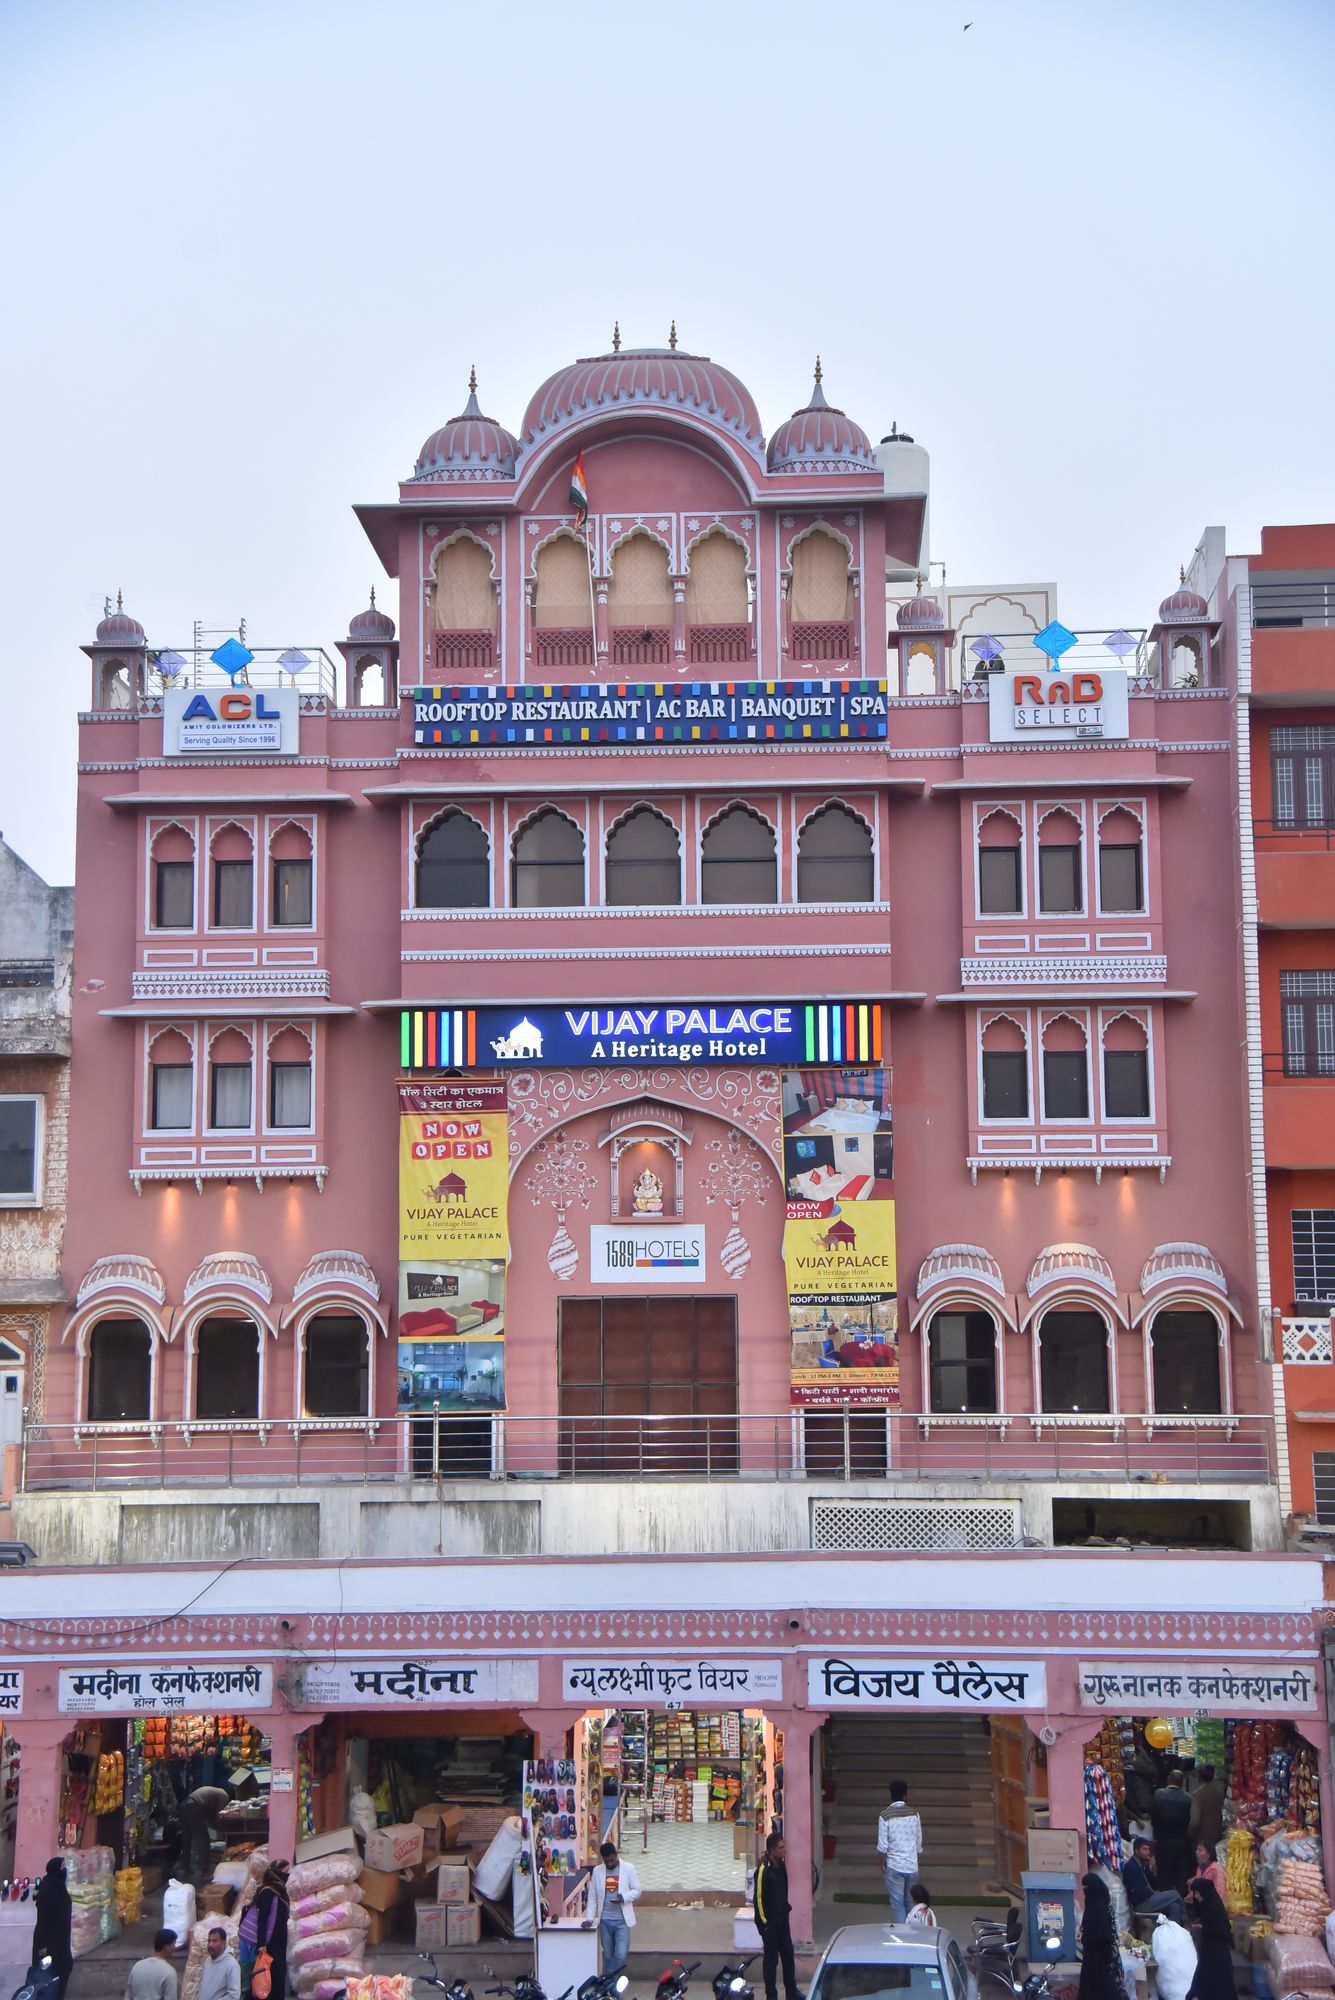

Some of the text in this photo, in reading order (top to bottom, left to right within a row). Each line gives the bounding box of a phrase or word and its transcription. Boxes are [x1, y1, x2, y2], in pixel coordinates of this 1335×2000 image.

[182, 694, 280, 720] ACL
[415, 696, 887, 722] ROOFTOP RESTAURANT AC BAR BANQUET SPA
[1018, 708, 1102, 724] SELECT
[184, 737, 210, 745] Serving
[212, 736, 237, 745] Quality
[239, 736, 258, 744] Since
[565, 1008, 792, 1035] VIJAY PALACE
[591, 1038, 766, 1061] A Heritage Hotel
[423, 1086, 447, 1096] सिटी
[450, 1087, 465, 1095] का
[467, 1086, 504, 1096] एकमात्र
[430, 1100, 452, 1109] स्टार
[455, 1097, 483, 1109] होटल
[425, 1122, 480, 1137] NOW
[415, 1143, 489, 1157] OPEN
[407, 1207, 499, 1219] VIJAY PALACE
[787, 1211, 822, 1219] OPEN
[436, 1232, 502, 1240] VEGETARIAN
[605, 1240, 700, 1267] 1589 HOTELS
[796, 1255, 889, 1268] VIJAY PALACE
[823, 1269, 850, 1277] Heritage
[827, 1281, 893, 1289] VEGETARIAN
[831, 1294, 881, 1303] RESTAURANT
[350, 1662, 478, 1699] मदीना
[821, 1658, 1029, 1702] विजय पैलेस
